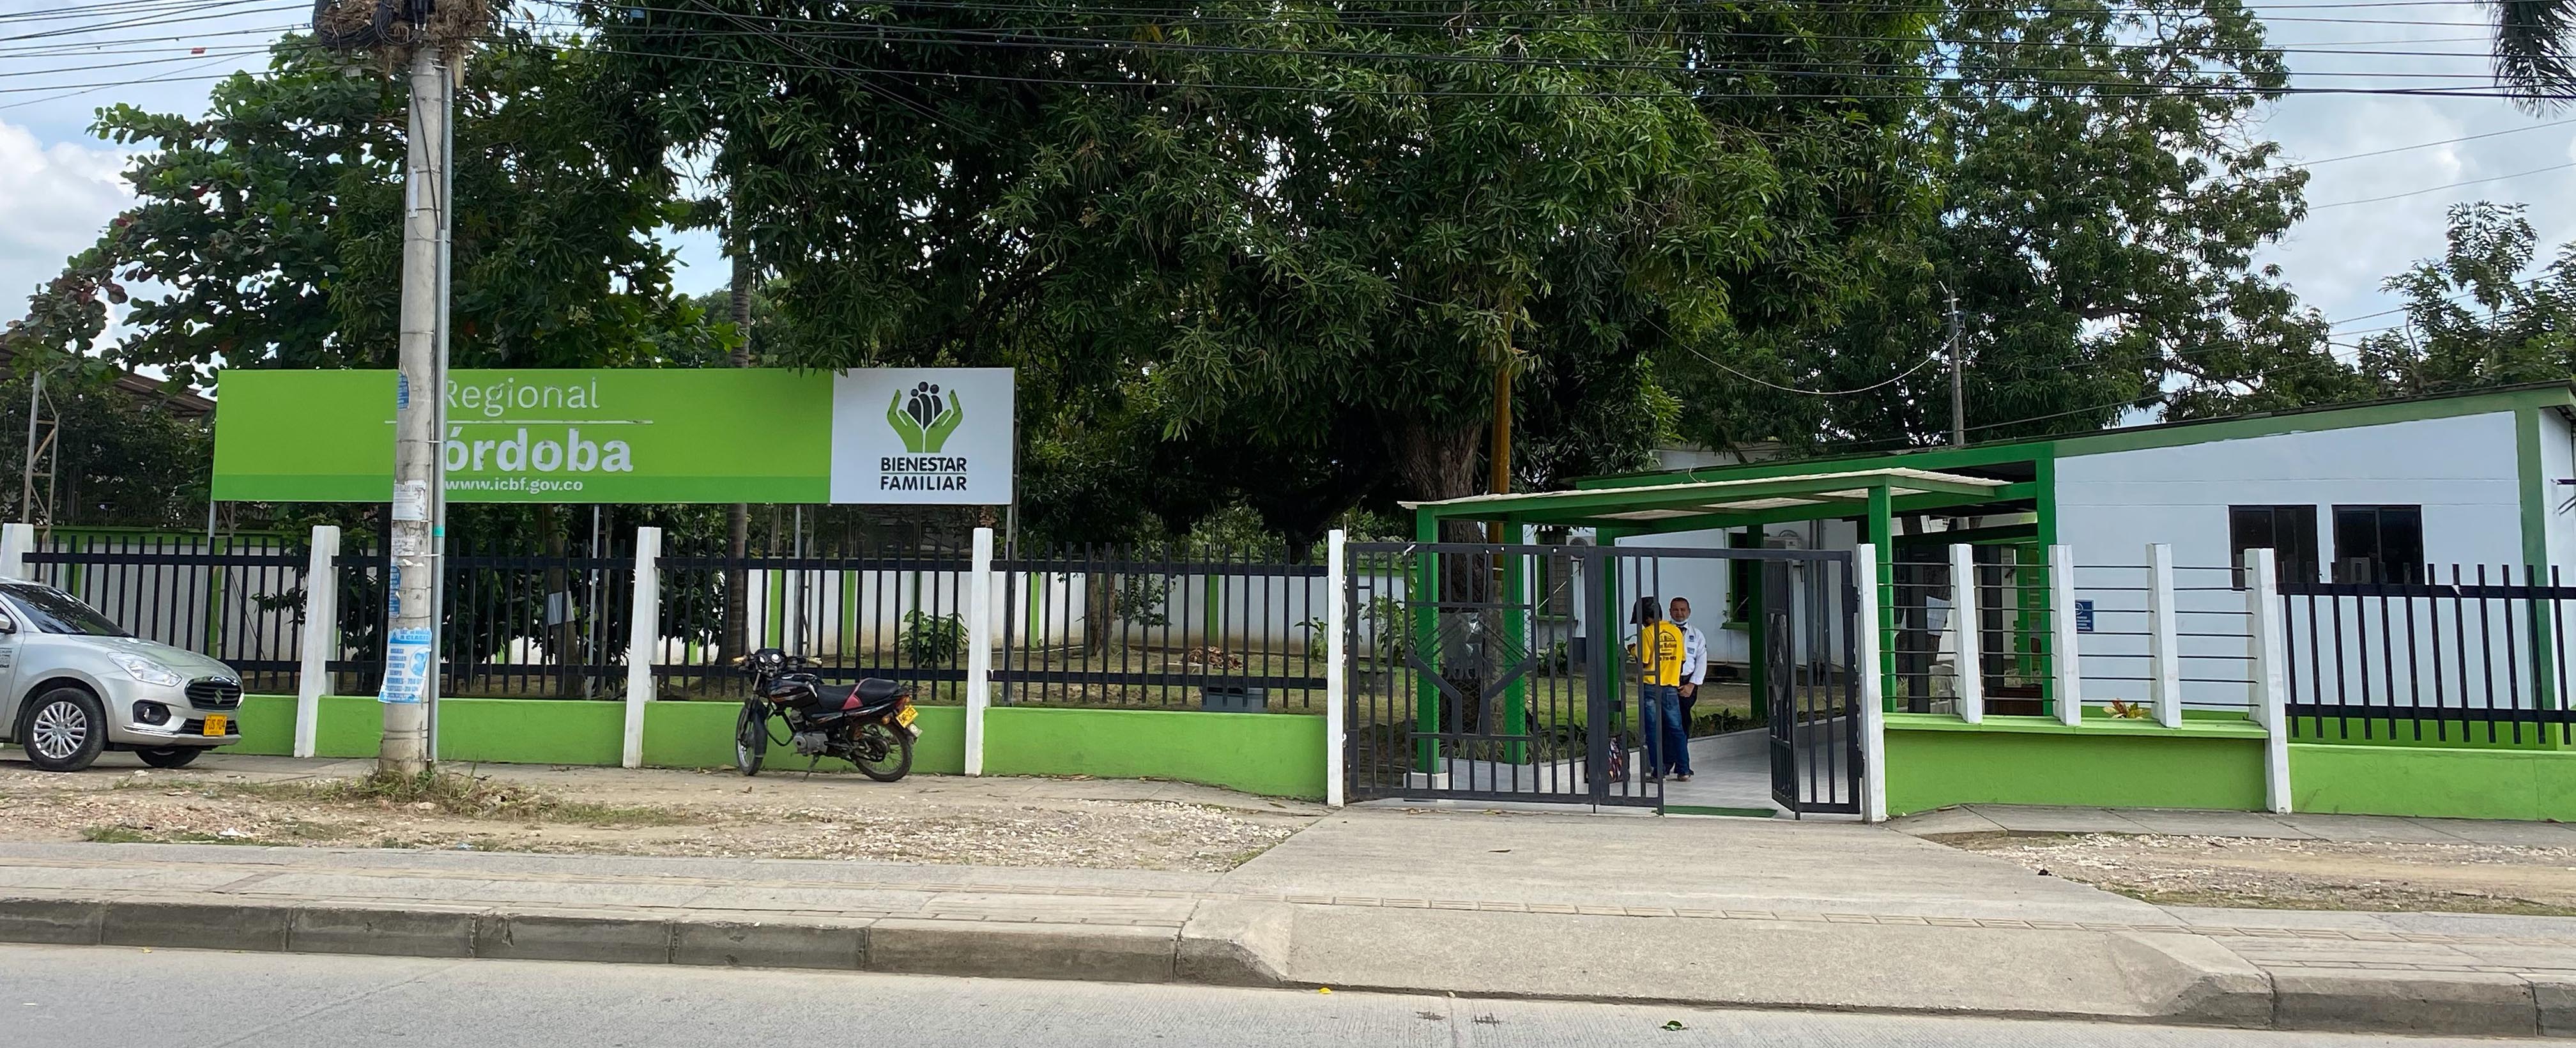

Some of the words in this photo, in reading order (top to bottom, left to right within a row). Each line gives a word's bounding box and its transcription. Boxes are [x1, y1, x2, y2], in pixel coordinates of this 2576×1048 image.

[445, 426, 634, 472] órdoba
[880, 457, 967, 472] BIENESTAR
[445, 477, 583, 494] www.icbf.gov.co
[880, 475, 967, 491] FAMILIAR
